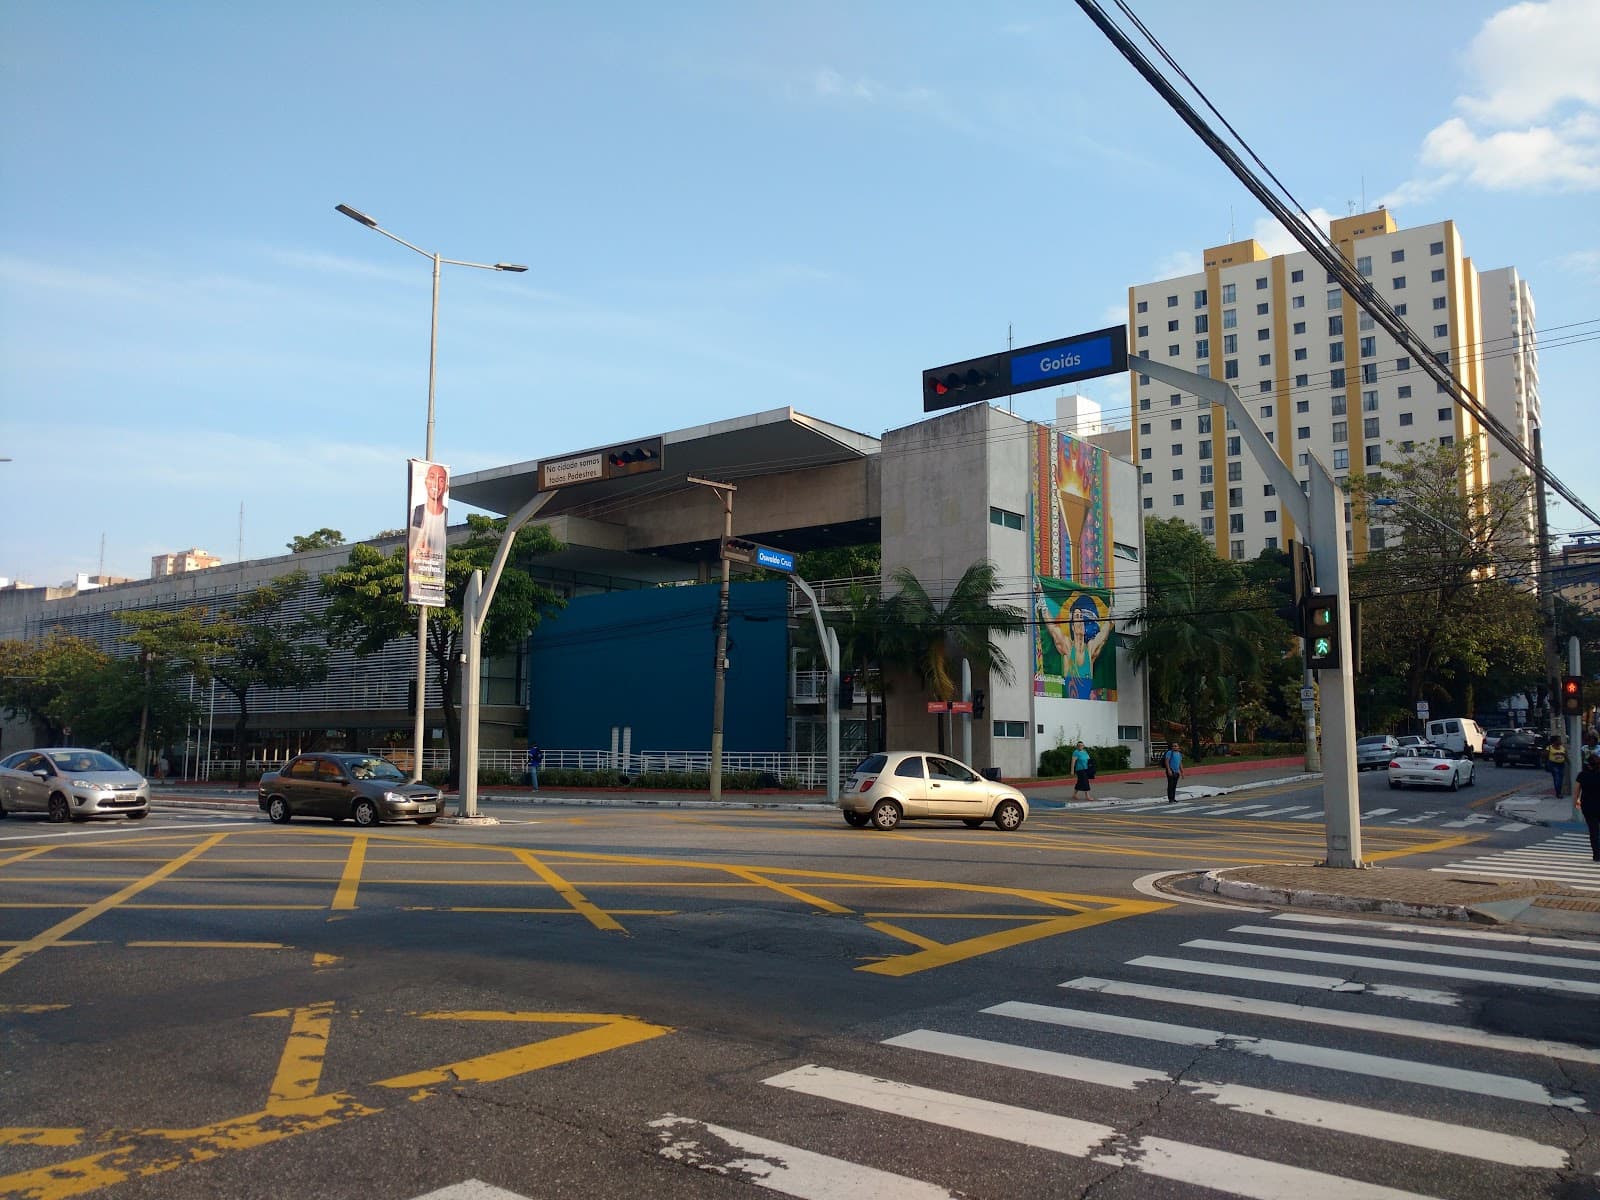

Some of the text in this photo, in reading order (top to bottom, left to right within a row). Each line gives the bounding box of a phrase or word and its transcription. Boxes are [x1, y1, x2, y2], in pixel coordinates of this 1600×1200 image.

[1040, 352, 1081, 372] Goiás
[579, 458, 600, 467] somos
[567, 469, 597, 481] Pedestres
[759, 552, 792, 567] Oswaldo Cruz
